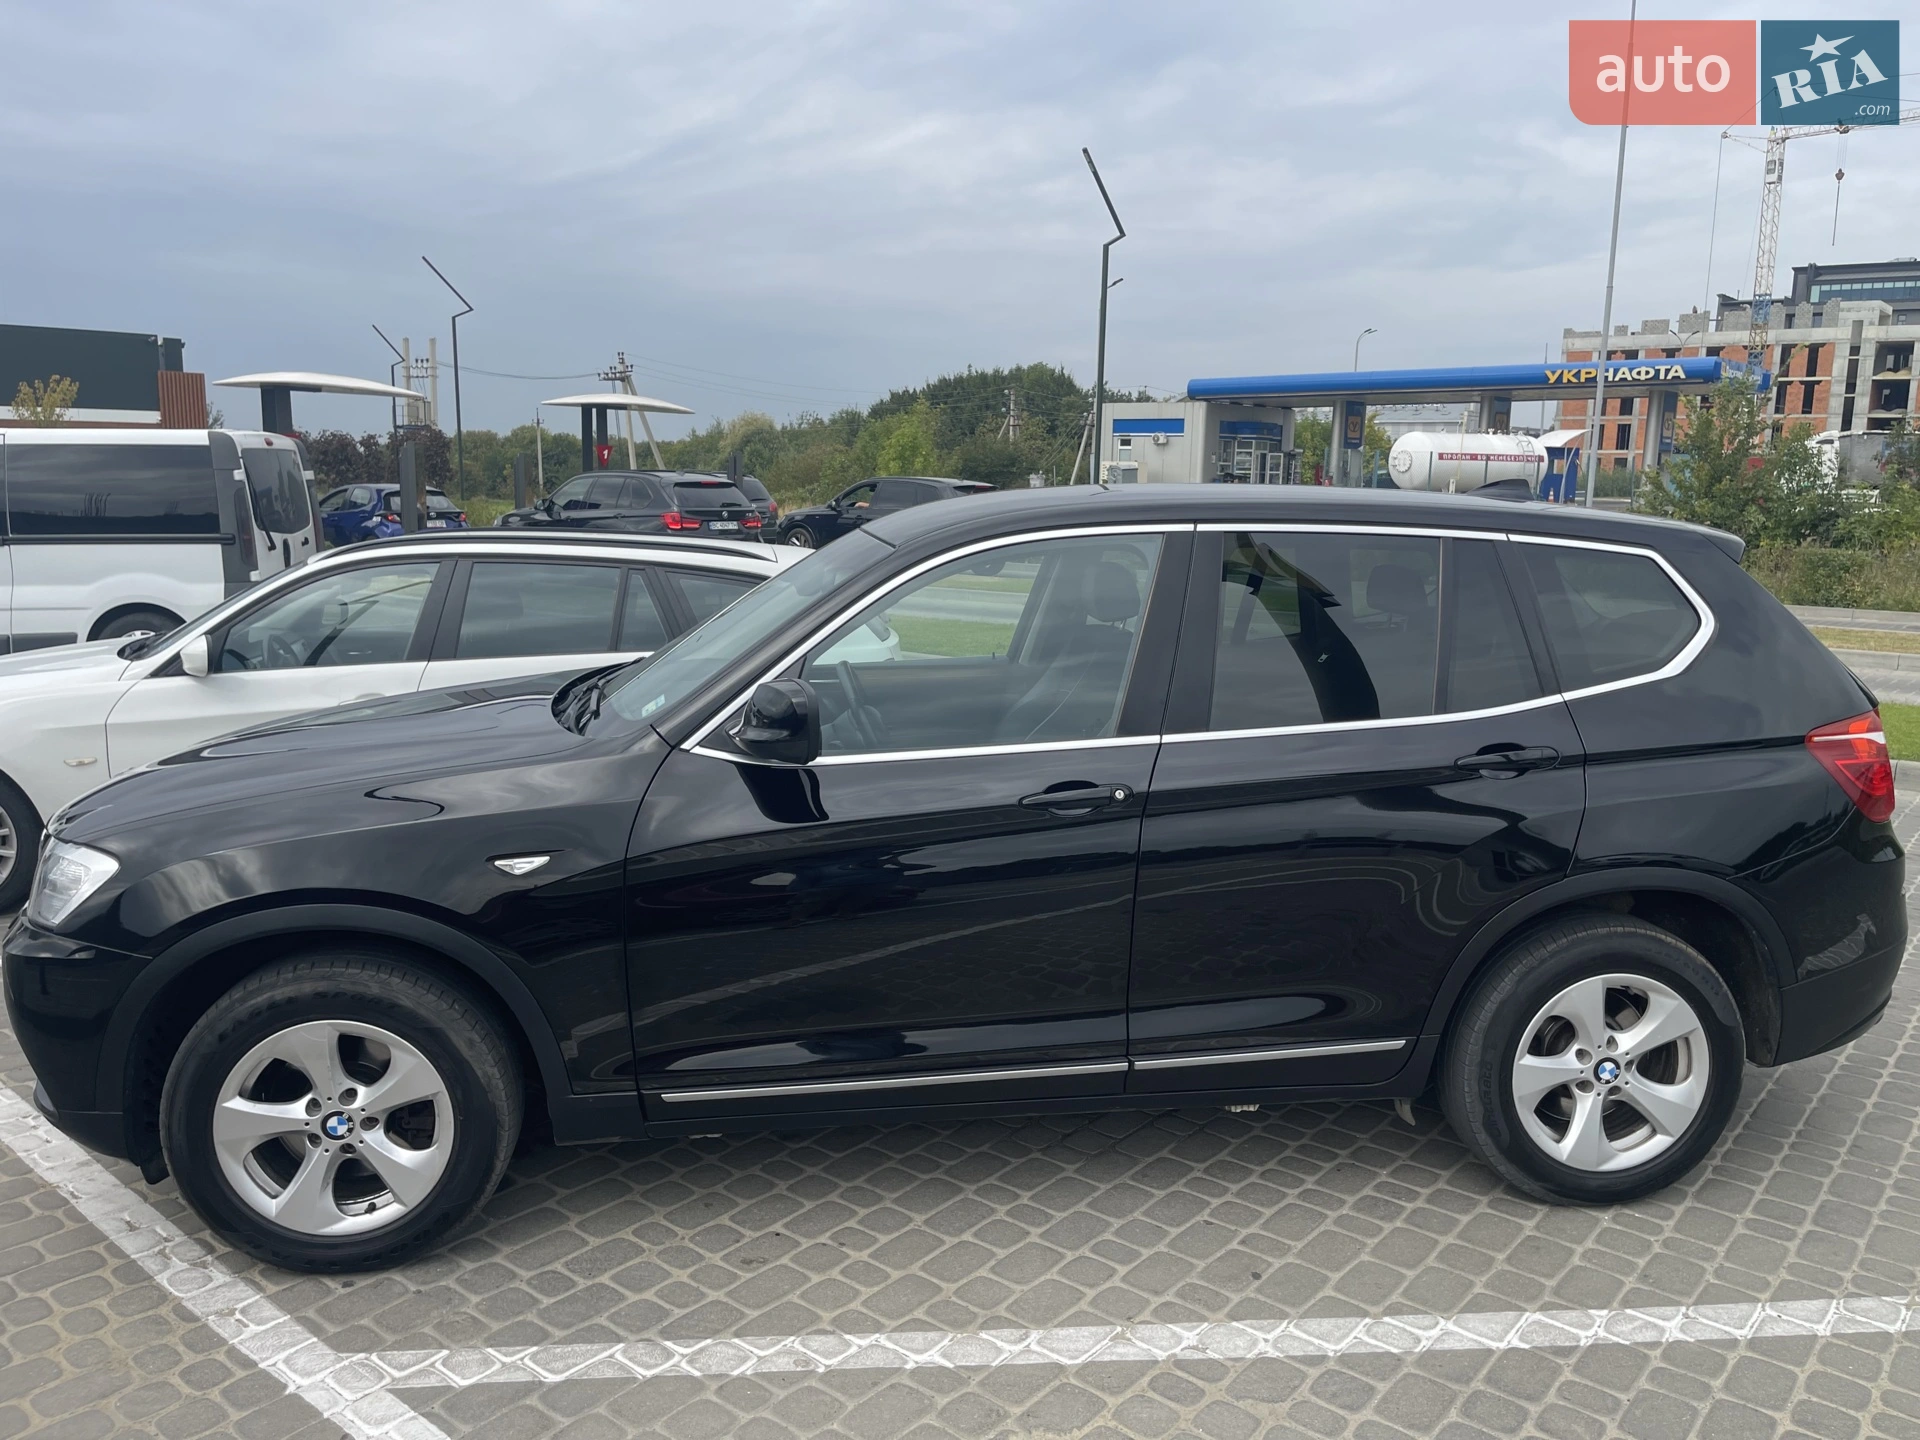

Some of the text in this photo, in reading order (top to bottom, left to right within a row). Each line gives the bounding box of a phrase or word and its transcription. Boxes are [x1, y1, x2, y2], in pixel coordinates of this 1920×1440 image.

[1544, 365, 1686, 384] УКРНАФТА
[602, 449, 609, 459] 1
[1477, 454, 1539, 462] ВОНЕНЕБЕЗПЕЧН
